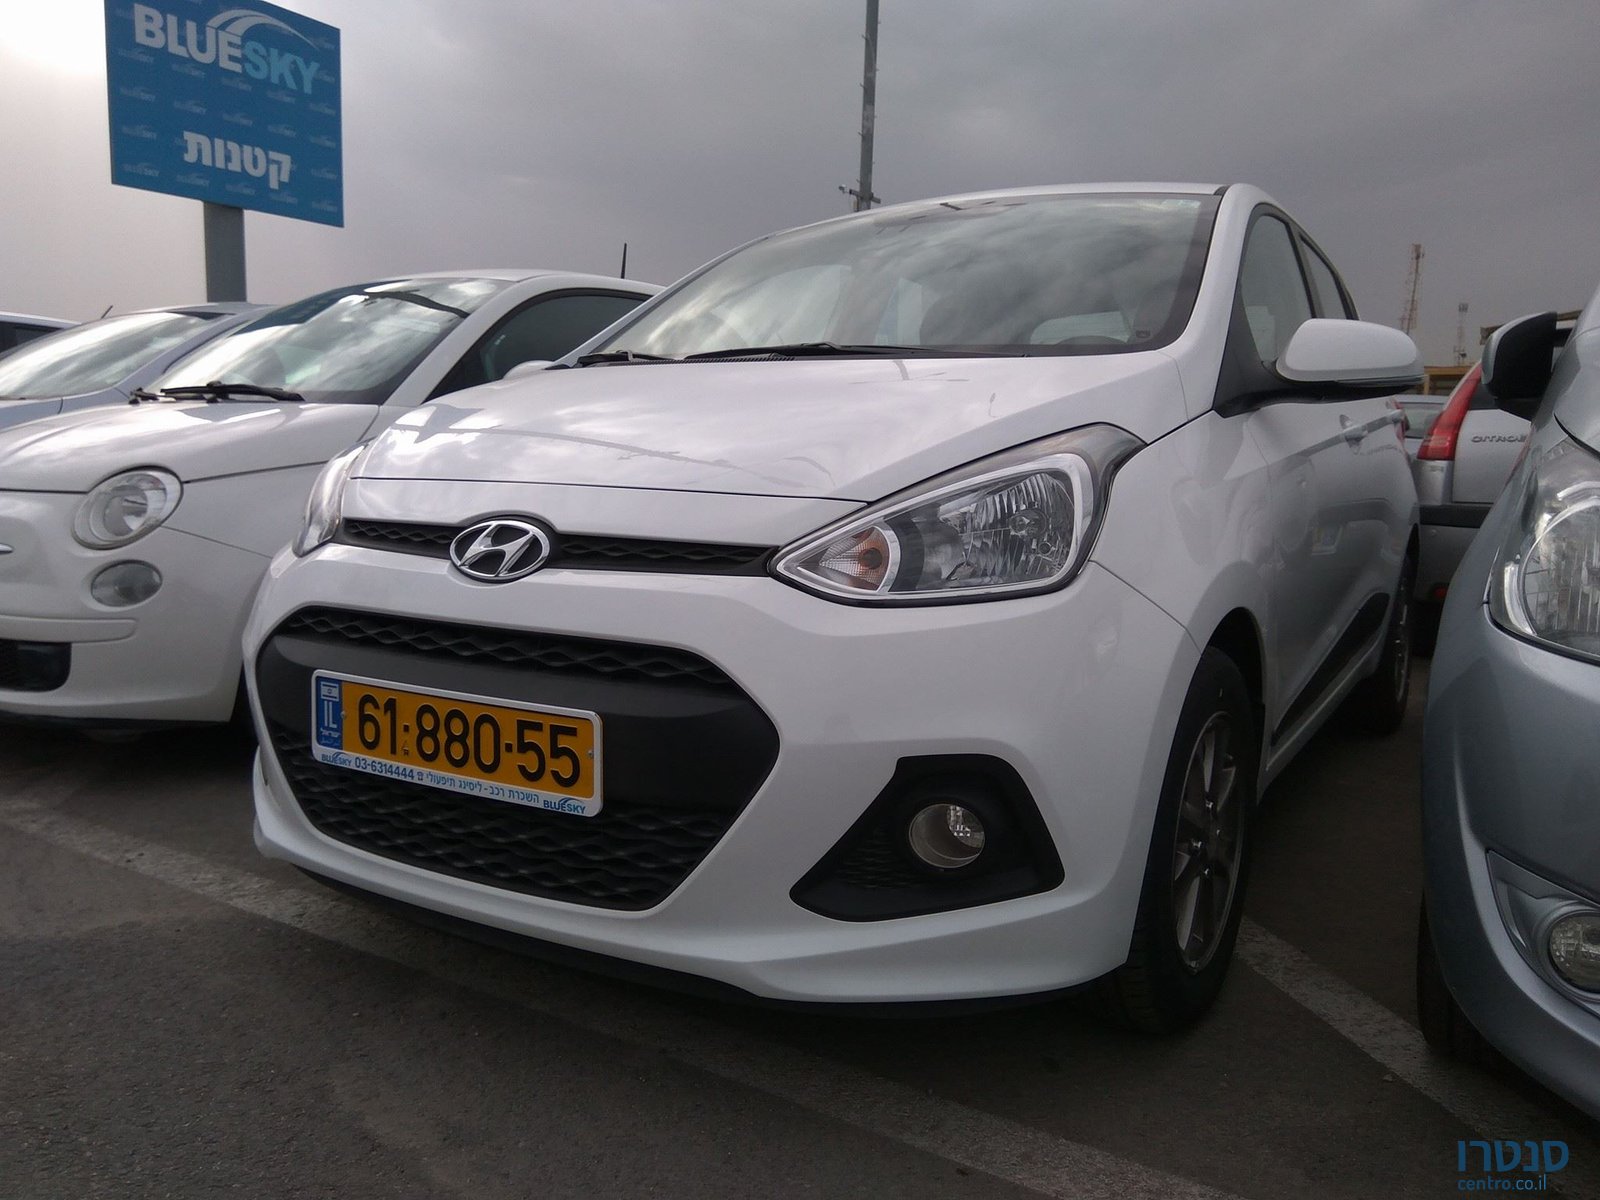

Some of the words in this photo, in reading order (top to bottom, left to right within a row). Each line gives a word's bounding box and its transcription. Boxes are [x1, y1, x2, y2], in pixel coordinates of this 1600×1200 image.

[133, 3, 320, 95] BLUESKY
[183, 130, 292, 190] קטנות
[1471, 434, 1527, 443] CITROE
[324, 700, 338, 729] IL
[354, 756, 415, 781] 03-6314444
[508, 789, 540, 804] השכרת
[543, 799, 587, 815] BLUESKY
